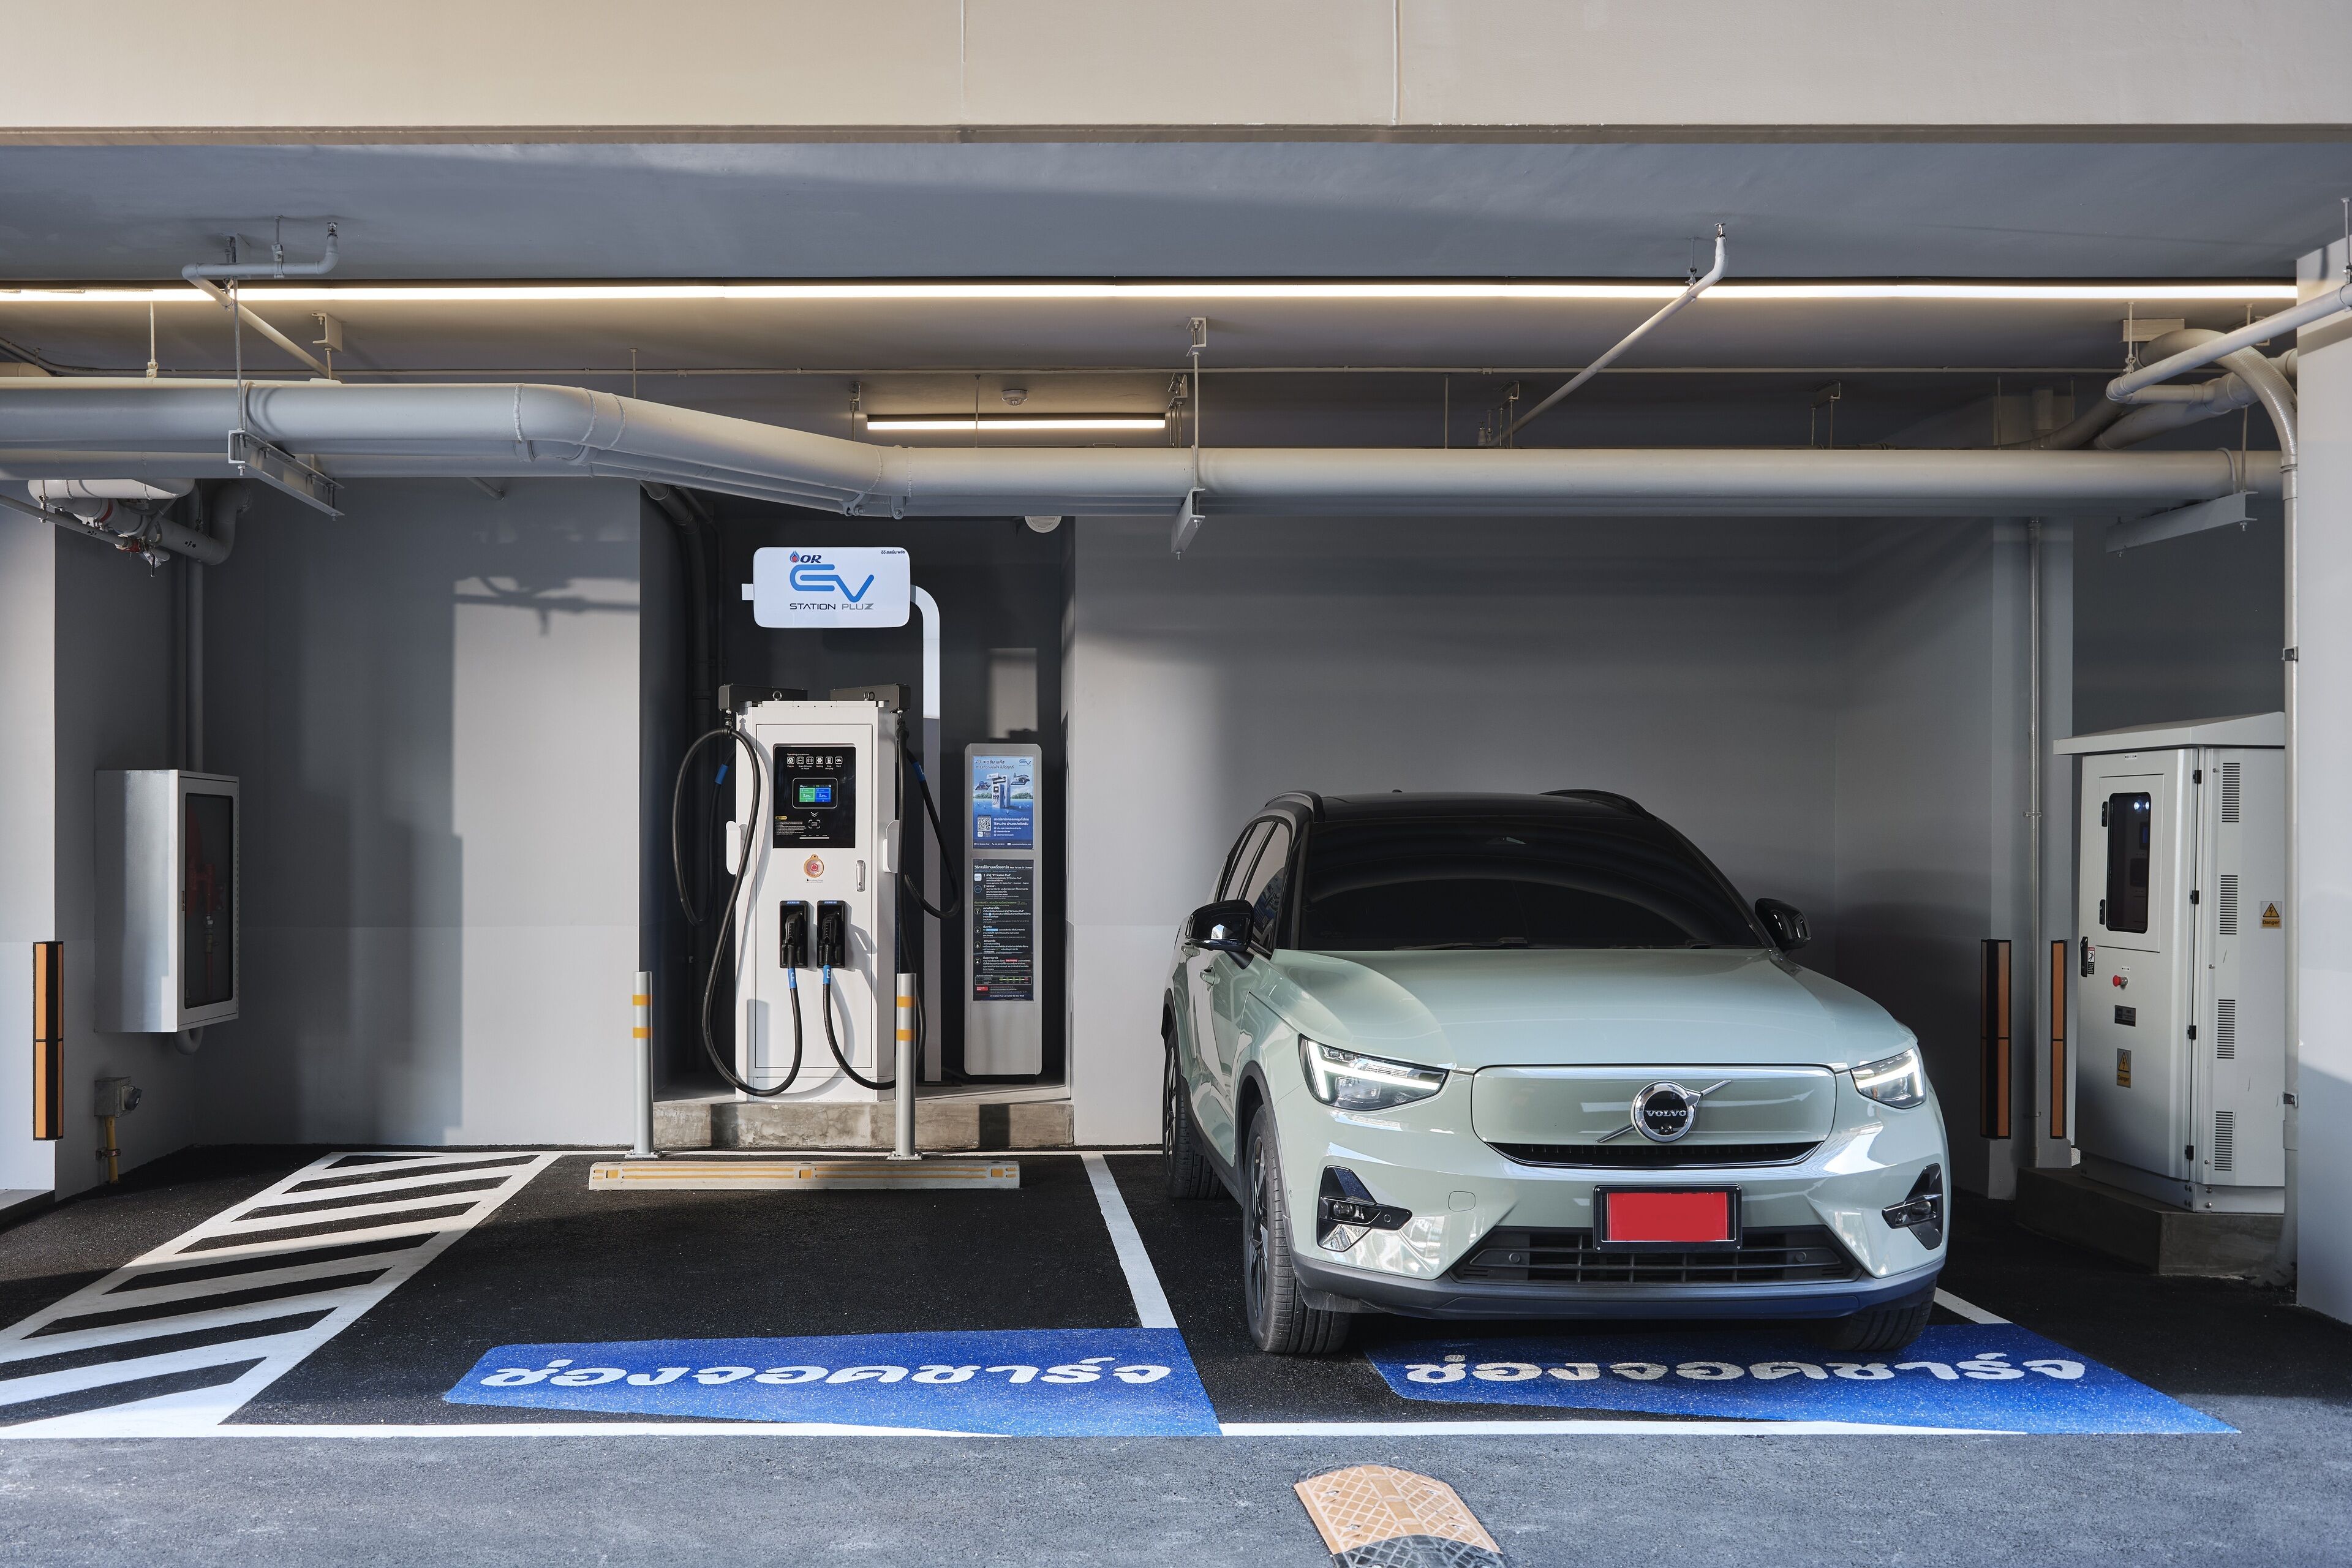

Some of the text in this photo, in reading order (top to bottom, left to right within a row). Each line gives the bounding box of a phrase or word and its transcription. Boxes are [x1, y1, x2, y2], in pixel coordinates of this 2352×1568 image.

[800, 554, 822, 564] OR
[790, 564, 875, 603] EV
[480, 1357, 1171, 1387] ช่องจอดชาร์จ
[1404, 1352, 2086, 1383] ช่องจอดชาร์จ
